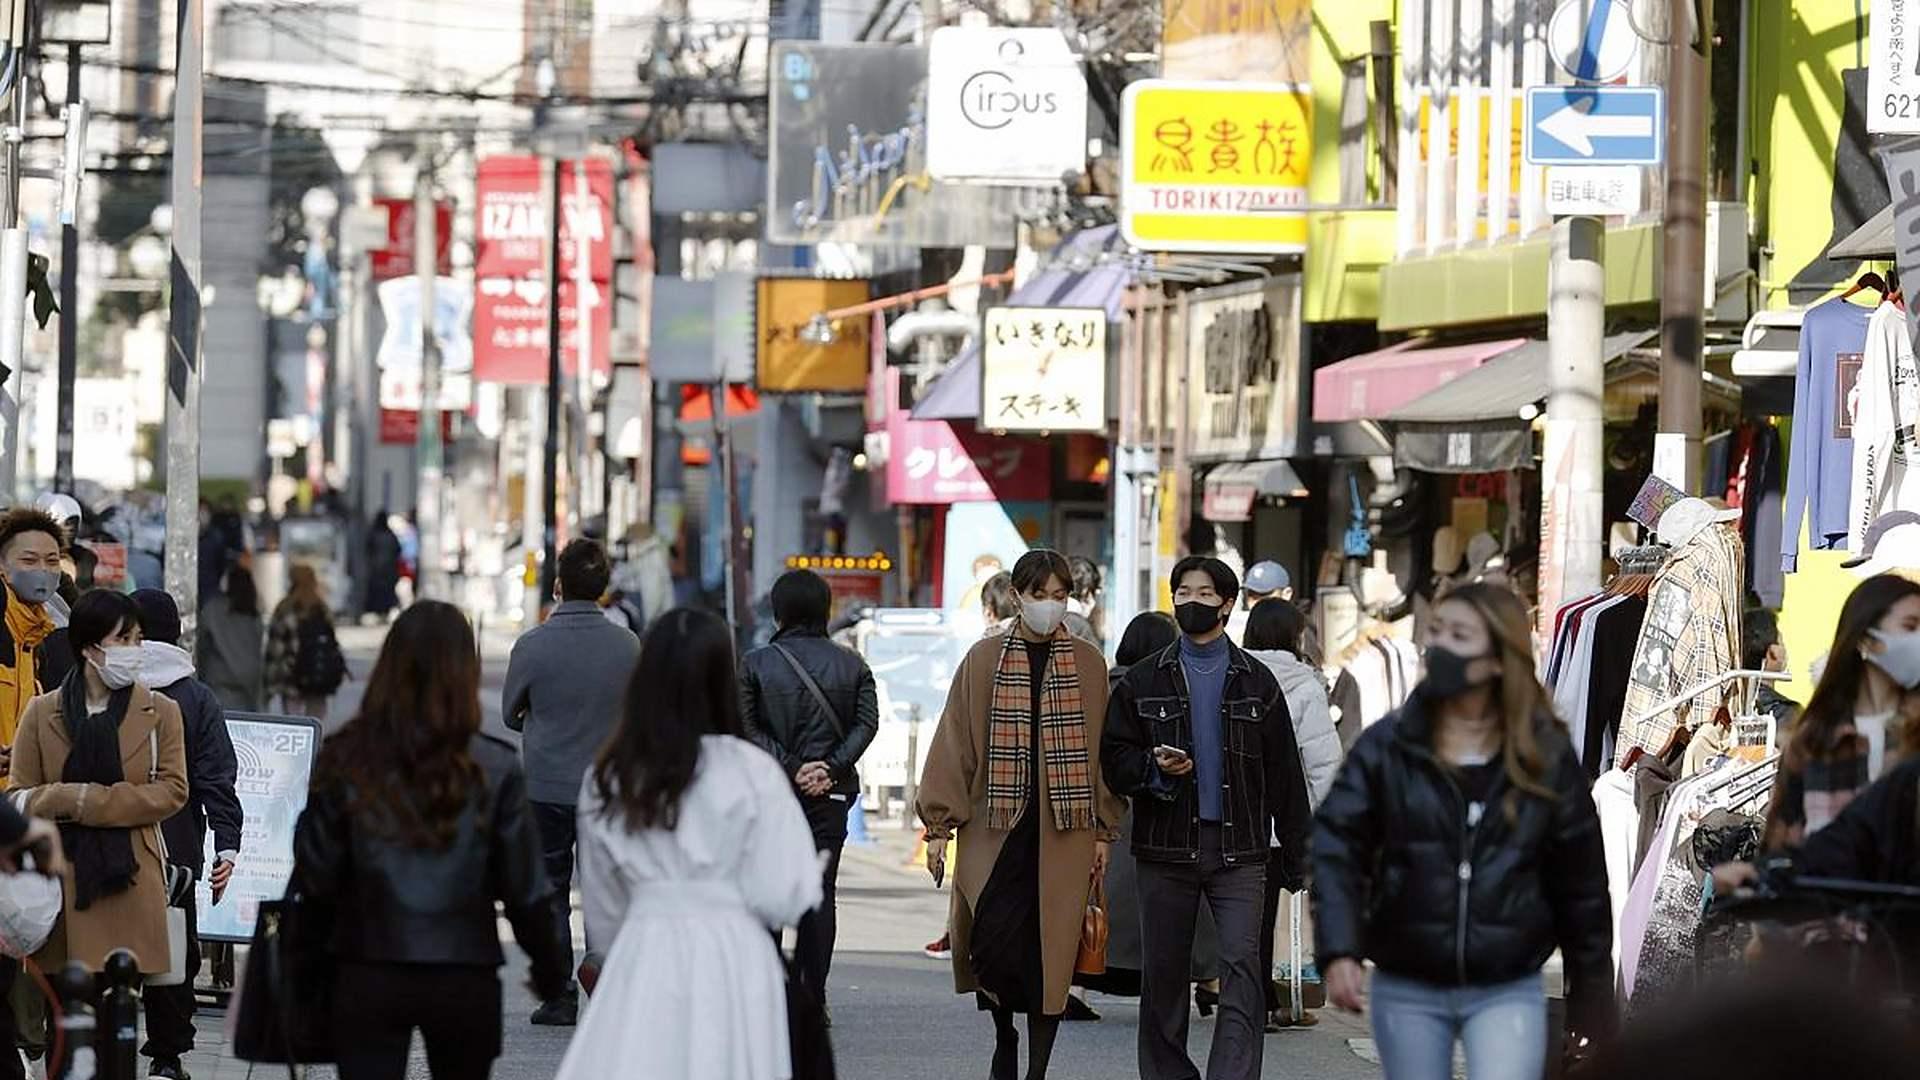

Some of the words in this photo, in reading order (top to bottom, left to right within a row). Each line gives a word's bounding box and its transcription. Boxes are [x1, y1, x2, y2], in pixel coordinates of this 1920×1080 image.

[960, 70, 1058, 130] Circus
[1150, 117, 1298, 176] 鳥貴族
[1151, 188, 1300, 211] TORIKIZOKU
[482, 202, 604, 242] IZAKYA
[994, 318, 1096, 349] いきなり
[998, 393, 1083, 420] ステーキ
[273, 734, 306, 755] 2F
